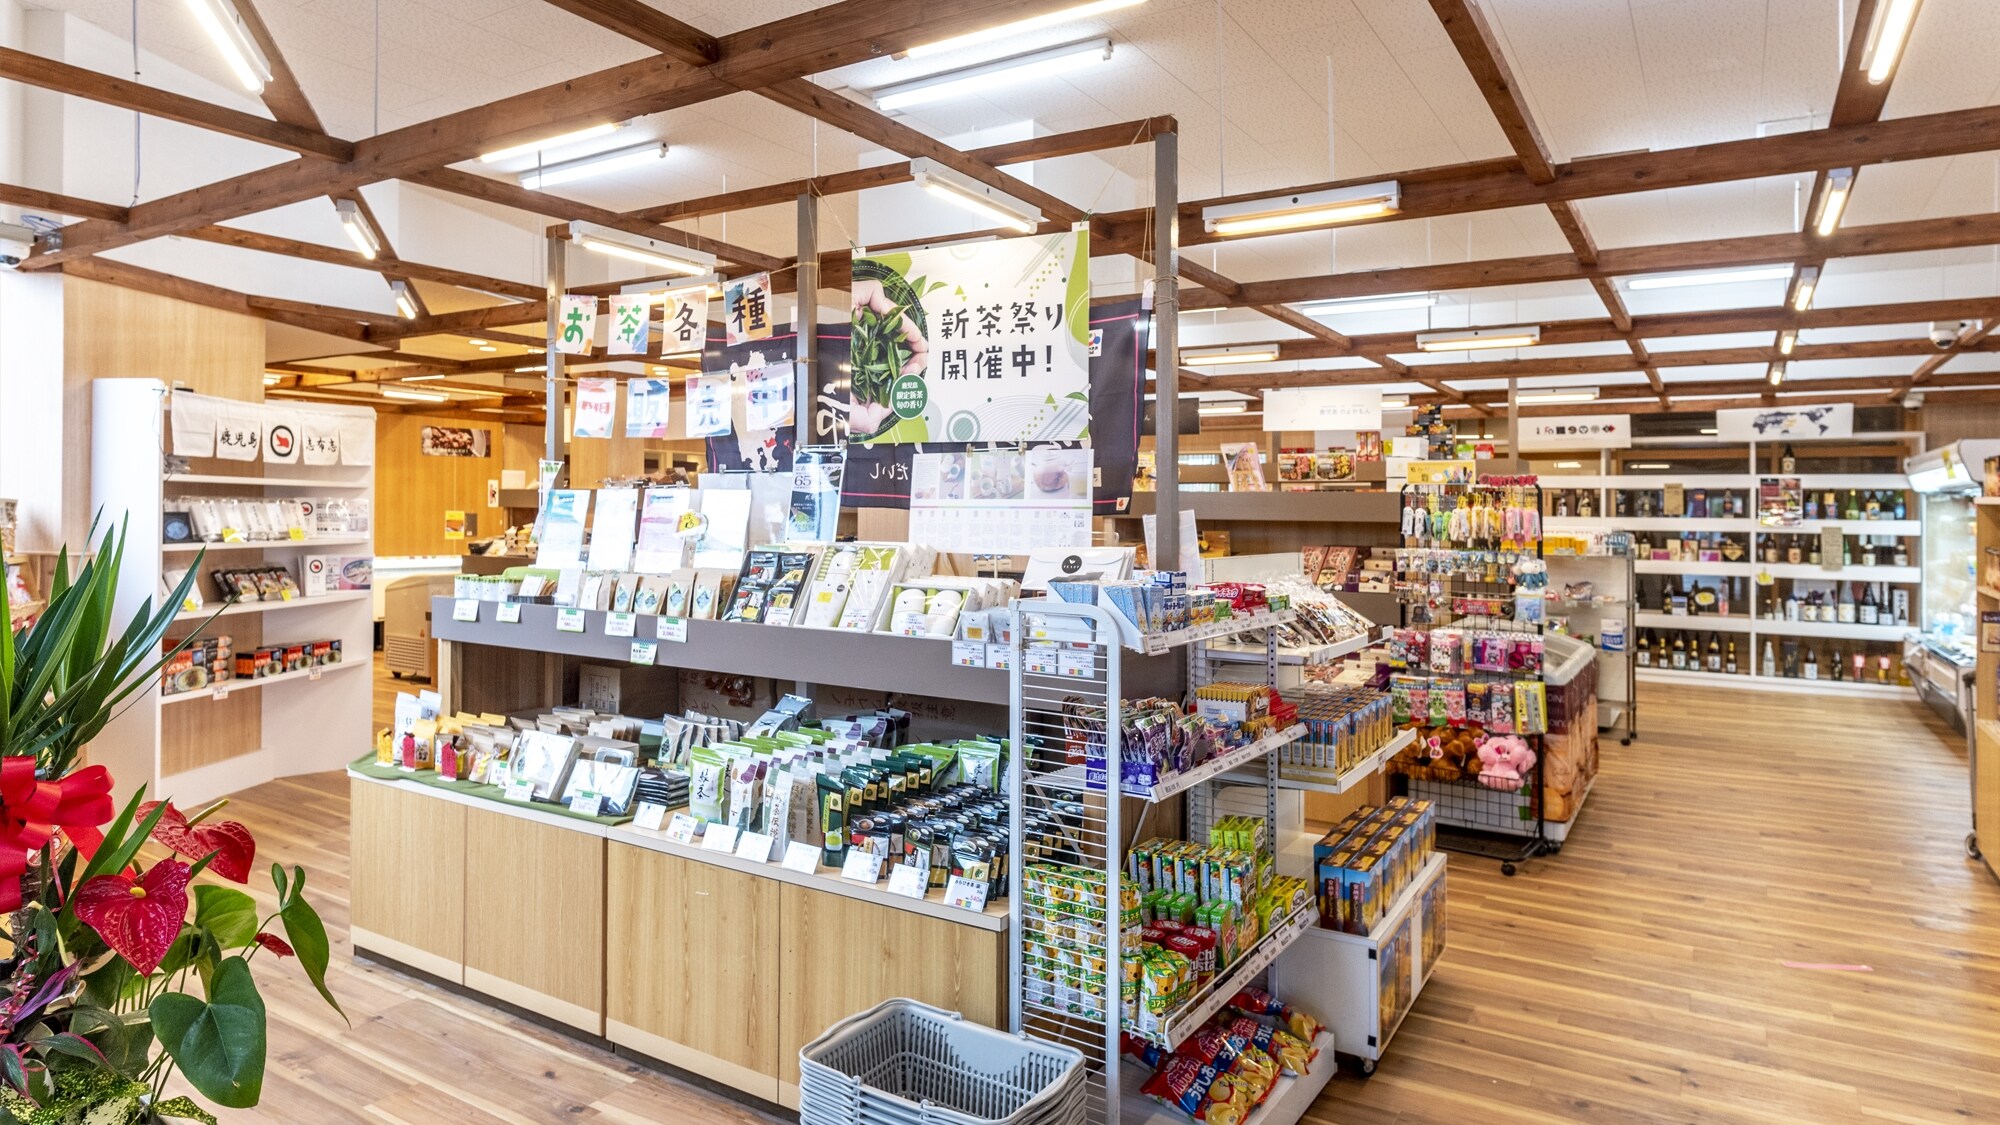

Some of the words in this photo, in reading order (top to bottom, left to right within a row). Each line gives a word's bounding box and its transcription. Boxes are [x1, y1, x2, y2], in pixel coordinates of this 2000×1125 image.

[564, 285, 767, 345] お茶各種
[941, 302, 1063, 340] 新茶祭り
[941, 344, 1053, 380] 開催中!
[1188, 1064, 1217, 1101] うすしお
